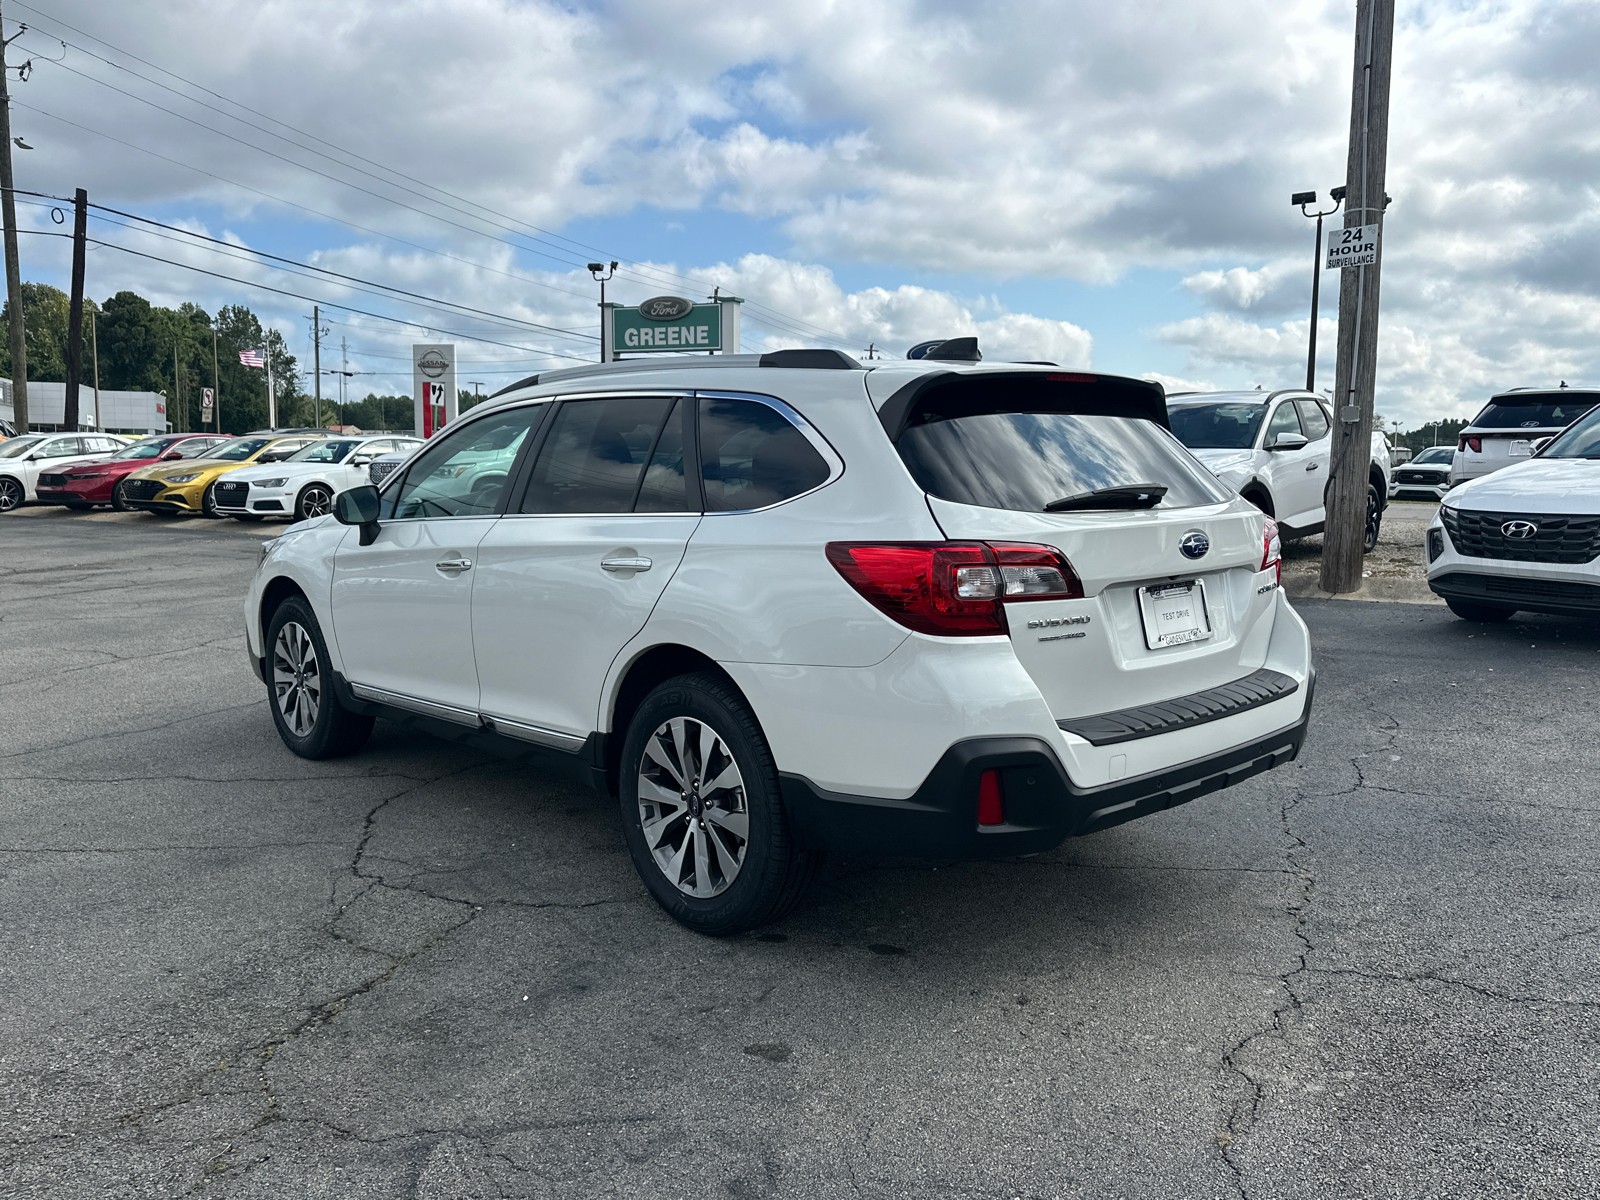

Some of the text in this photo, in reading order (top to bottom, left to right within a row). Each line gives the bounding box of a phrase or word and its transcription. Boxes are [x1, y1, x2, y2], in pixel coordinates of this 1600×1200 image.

[1342, 228, 1362, 244] 24
[1329, 243, 1374, 256] HOUR
[1328, 254, 1374, 268] SURVEILLANCE
[650, 301, 678, 316] Ford
[624, 325, 709, 347] GREENE
[1027, 615, 1090, 629] SUBARU
[1162, 609, 1190, 621] TEST DRIVE
